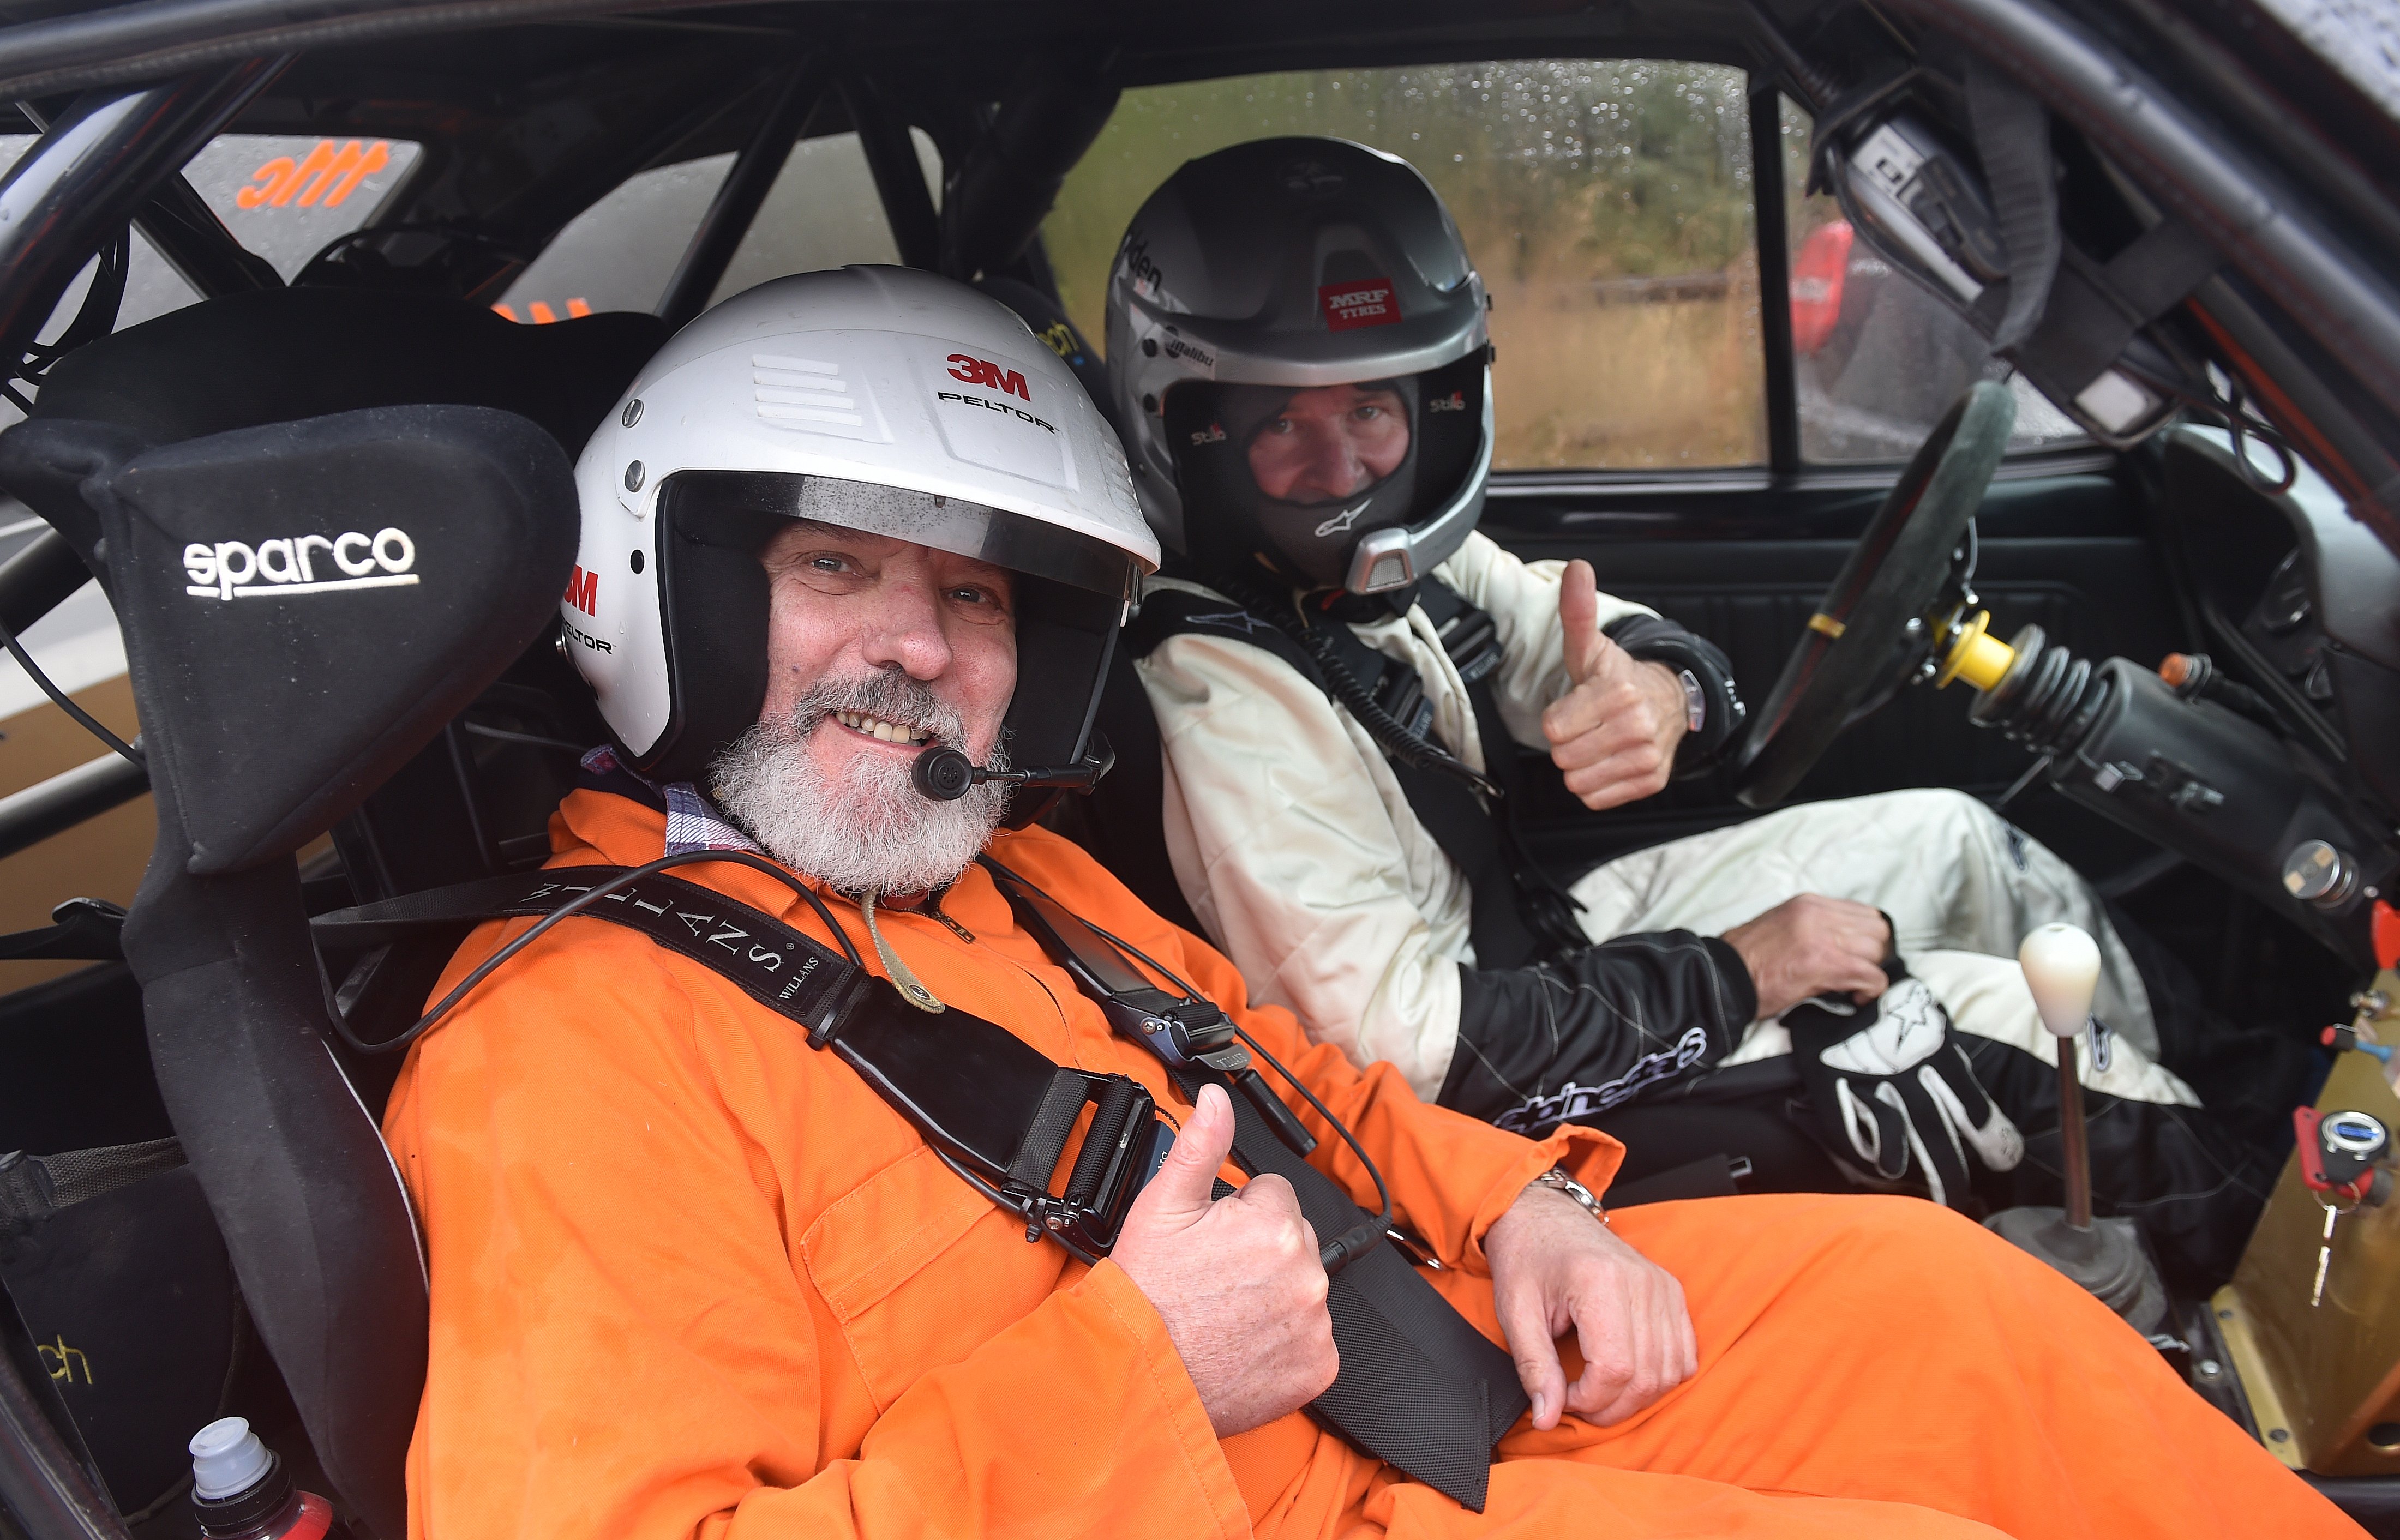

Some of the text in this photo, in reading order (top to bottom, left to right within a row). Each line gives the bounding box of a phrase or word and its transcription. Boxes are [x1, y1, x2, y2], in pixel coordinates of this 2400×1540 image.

[1329, 288, 1389, 310] MRF
[1339, 303, 1387, 320] TYRES
[946, 353, 1031, 402] 3M
[937, 391, 1055, 435] PELTOR
[183, 527, 415, 600] sparco
[518, 882, 783, 973] WILLANS
[778, 956, 819, 1000] WILLANS
